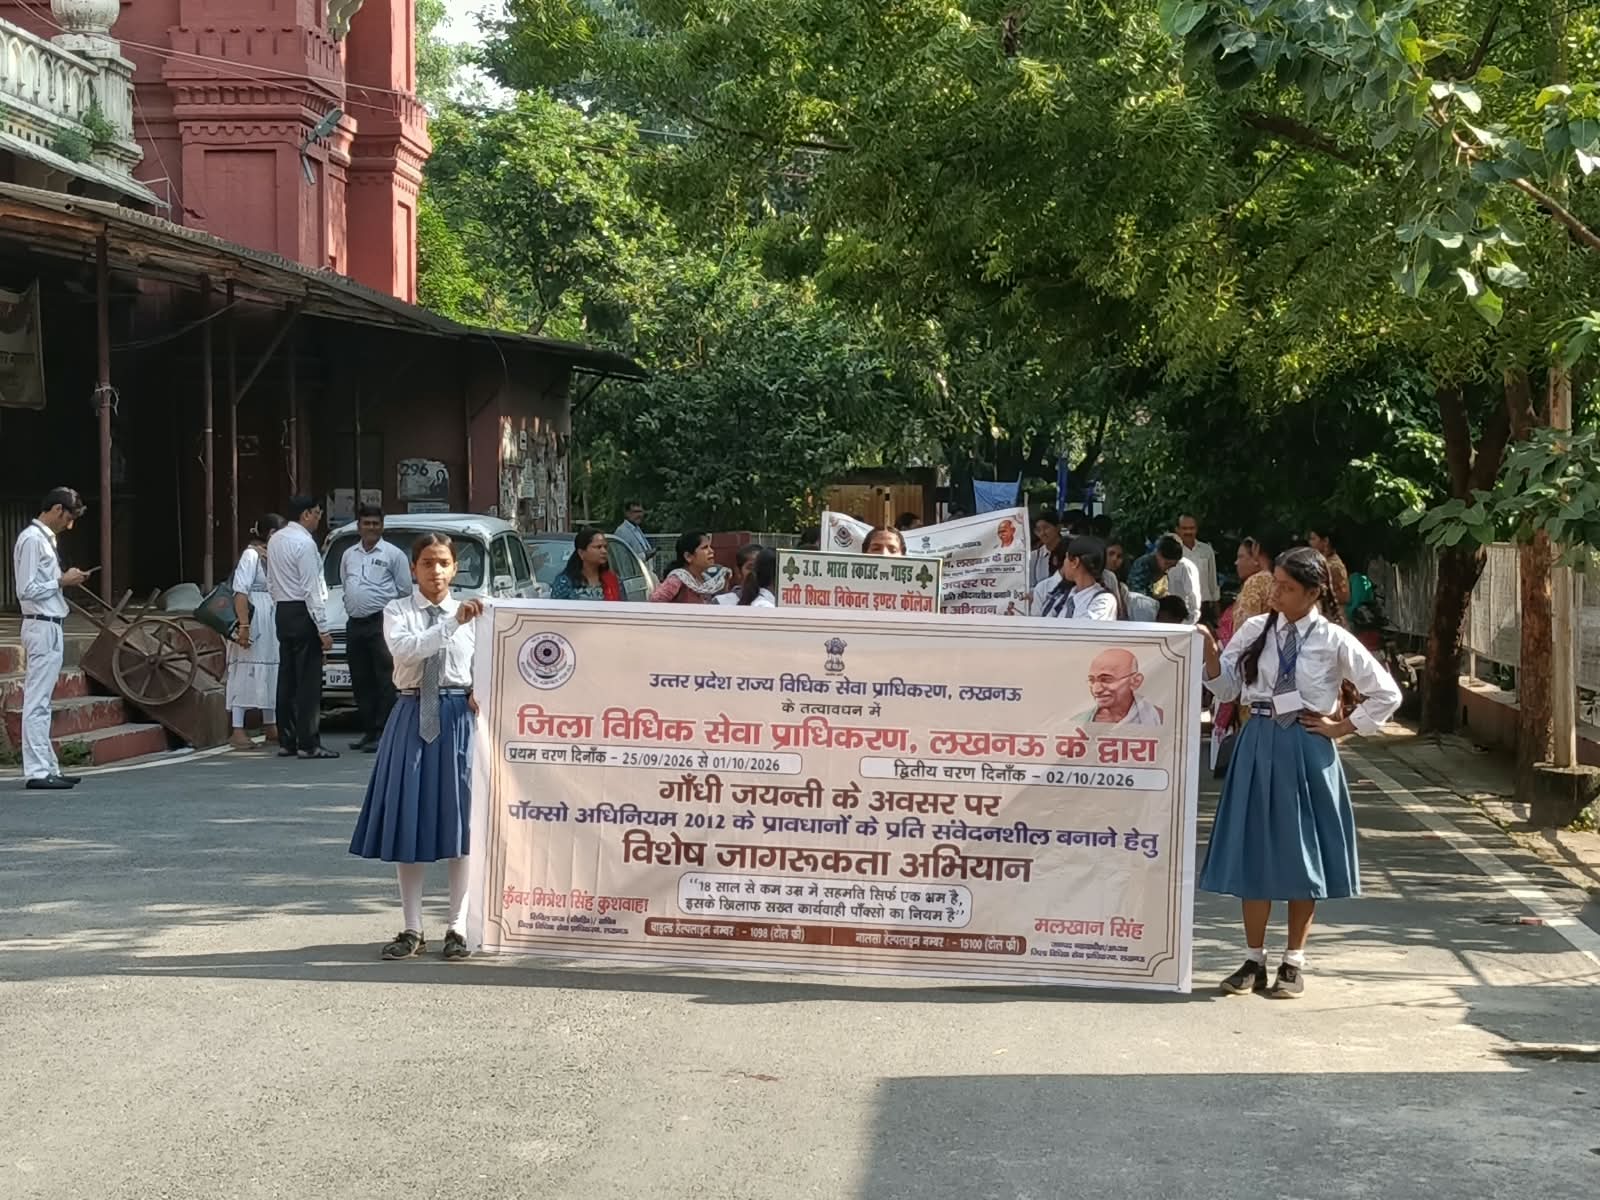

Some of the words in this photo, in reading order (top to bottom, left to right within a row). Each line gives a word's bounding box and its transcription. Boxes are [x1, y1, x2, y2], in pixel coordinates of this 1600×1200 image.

[851, 562, 879, 580] स्काउट
[891, 564, 914, 584] गाइड
[980, 578, 997, 588] पर
[781, 583, 801, 604] नारी
[805, 584, 830, 606] शिक्षा
[834, 586, 870, 608] निकेतन
[873, 592, 897, 610] इण्टर
[900, 590, 933, 612] कॉलेज
[330, 675, 341, 683] UP
[649, 672, 690, 689] उत्तर
[694, 671, 731, 691] प्रदेश
[737, 676, 774, 692] राज्य
[780, 673, 832, 693] विधिक
[835, 675, 867, 695] सेवा
[872, 677, 952, 701] प्राधिकरण,
[958, 685, 1023, 703] लखनऊ
[781, 698, 795, 713] के
[868, 702, 882, 717] में
[517, 704, 594, 738] जिला
[601, 707, 696, 742] विधिक
[704, 713, 762, 746] सेवा
[771, 716, 917, 754] प्राधिकरण,
[930, 729, 1047, 758] लखनऊ
[1055, 727, 1092, 759] के
[1097, 736, 1159, 764] द्वारा
[509, 747, 537, 761] प्रथम
[542, 749, 567, 761] चरण
[571, 745, 607, 763] दिनाँक
[622, 752, 693, 768] 25/09/2026
[697, 750, 709, 769] से
[712, 755, 781, 772] 01/10/2026
[894, 761, 937, 780] द्वितीय
[943, 765, 975, 781] चरण
[981, 763, 1026, 782] दिनाँक
[1045, 770, 1135, 787] 02/10/2026
[659, 773, 724, 804] गाँधी
[731, 778, 825, 809] जयन्ती
[832, 781, 863, 812] के
[869, 790, 958, 815] अवसर
[964, 794, 1002, 818] पर
[509, 800, 569, 823] पॉक्सो
[574, 802, 679, 828] अधिनियम
[684, 813, 726, 829] 2012
[732, 809, 757, 831] के
[762, 813, 852, 835] प्रावधानों
[855, 816, 879, 837] के
[885, 817, 925, 841] प्रति
[931, 820, 1053, 846] संवेदनशील
[1056, 826, 1117, 848] बनाने
[1123, 831, 1160, 859] हेतु
[622, 829, 708, 867] विशेष
[715, 841, 891, 876] जागरूकता
[898, 844, 1034, 883] अभियान
[503, 885, 530, 909] कुँवर
[532, 887, 567, 908] मित्रेश
[570, 889, 594, 911] सिंह
[598, 896, 650, 914] कुशवाहा
[715, 882, 740, 894] साल
[744, 879, 756, 895] से
[760, 884, 781, 896] कम
[808, 882, 819, 898] में
[824, 885, 865, 900] सहमति
[870, 886, 897, 902] सिर्फ
[901, 891, 921, 903] एक
[950, 889, 963, 907] है,
[685, 894, 716, 911] इसके
[719, 896, 762, 913] खिलाफ
[766, 902, 793, 914] सख्त
[798, 900, 846, 918] कार्यवाही
[889, 908, 905, 920] का
[909, 905, 943, 921] नियम
[750, 927, 768, 938] 1098
[1034, 918, 1105, 937] मलखान
[1110, 916, 1145, 940] सिंह
[960, 938, 982, 950] 15100
